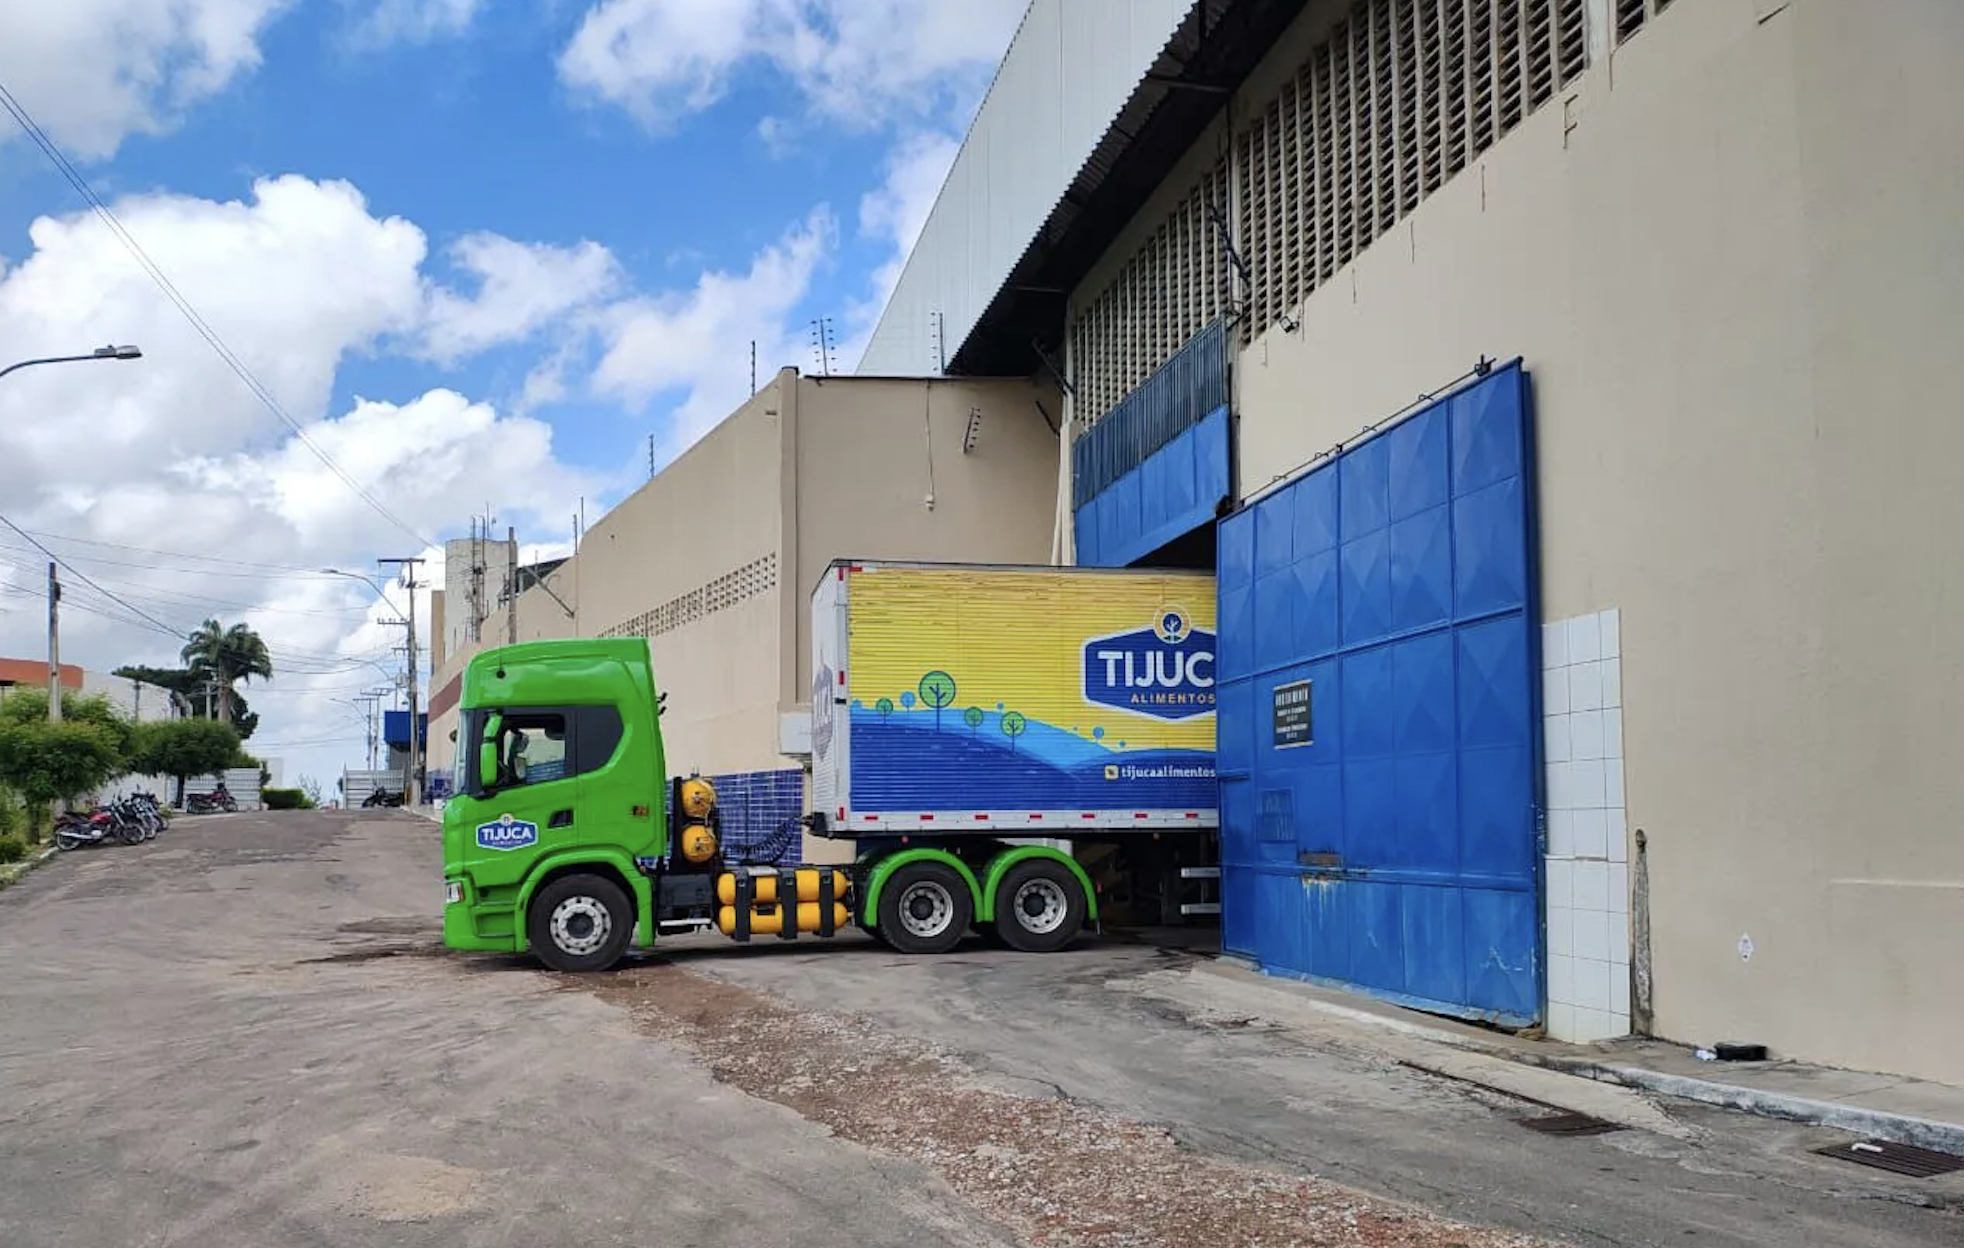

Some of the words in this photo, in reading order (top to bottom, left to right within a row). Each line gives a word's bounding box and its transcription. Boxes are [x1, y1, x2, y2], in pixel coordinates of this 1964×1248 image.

[1097, 651, 1215, 687] TIJUC
[1131, 693, 1216, 704] ALIMENTOS
[1121, 765, 1216, 780] tijucaalimentos
[481, 827, 533, 841] TIJUCA
